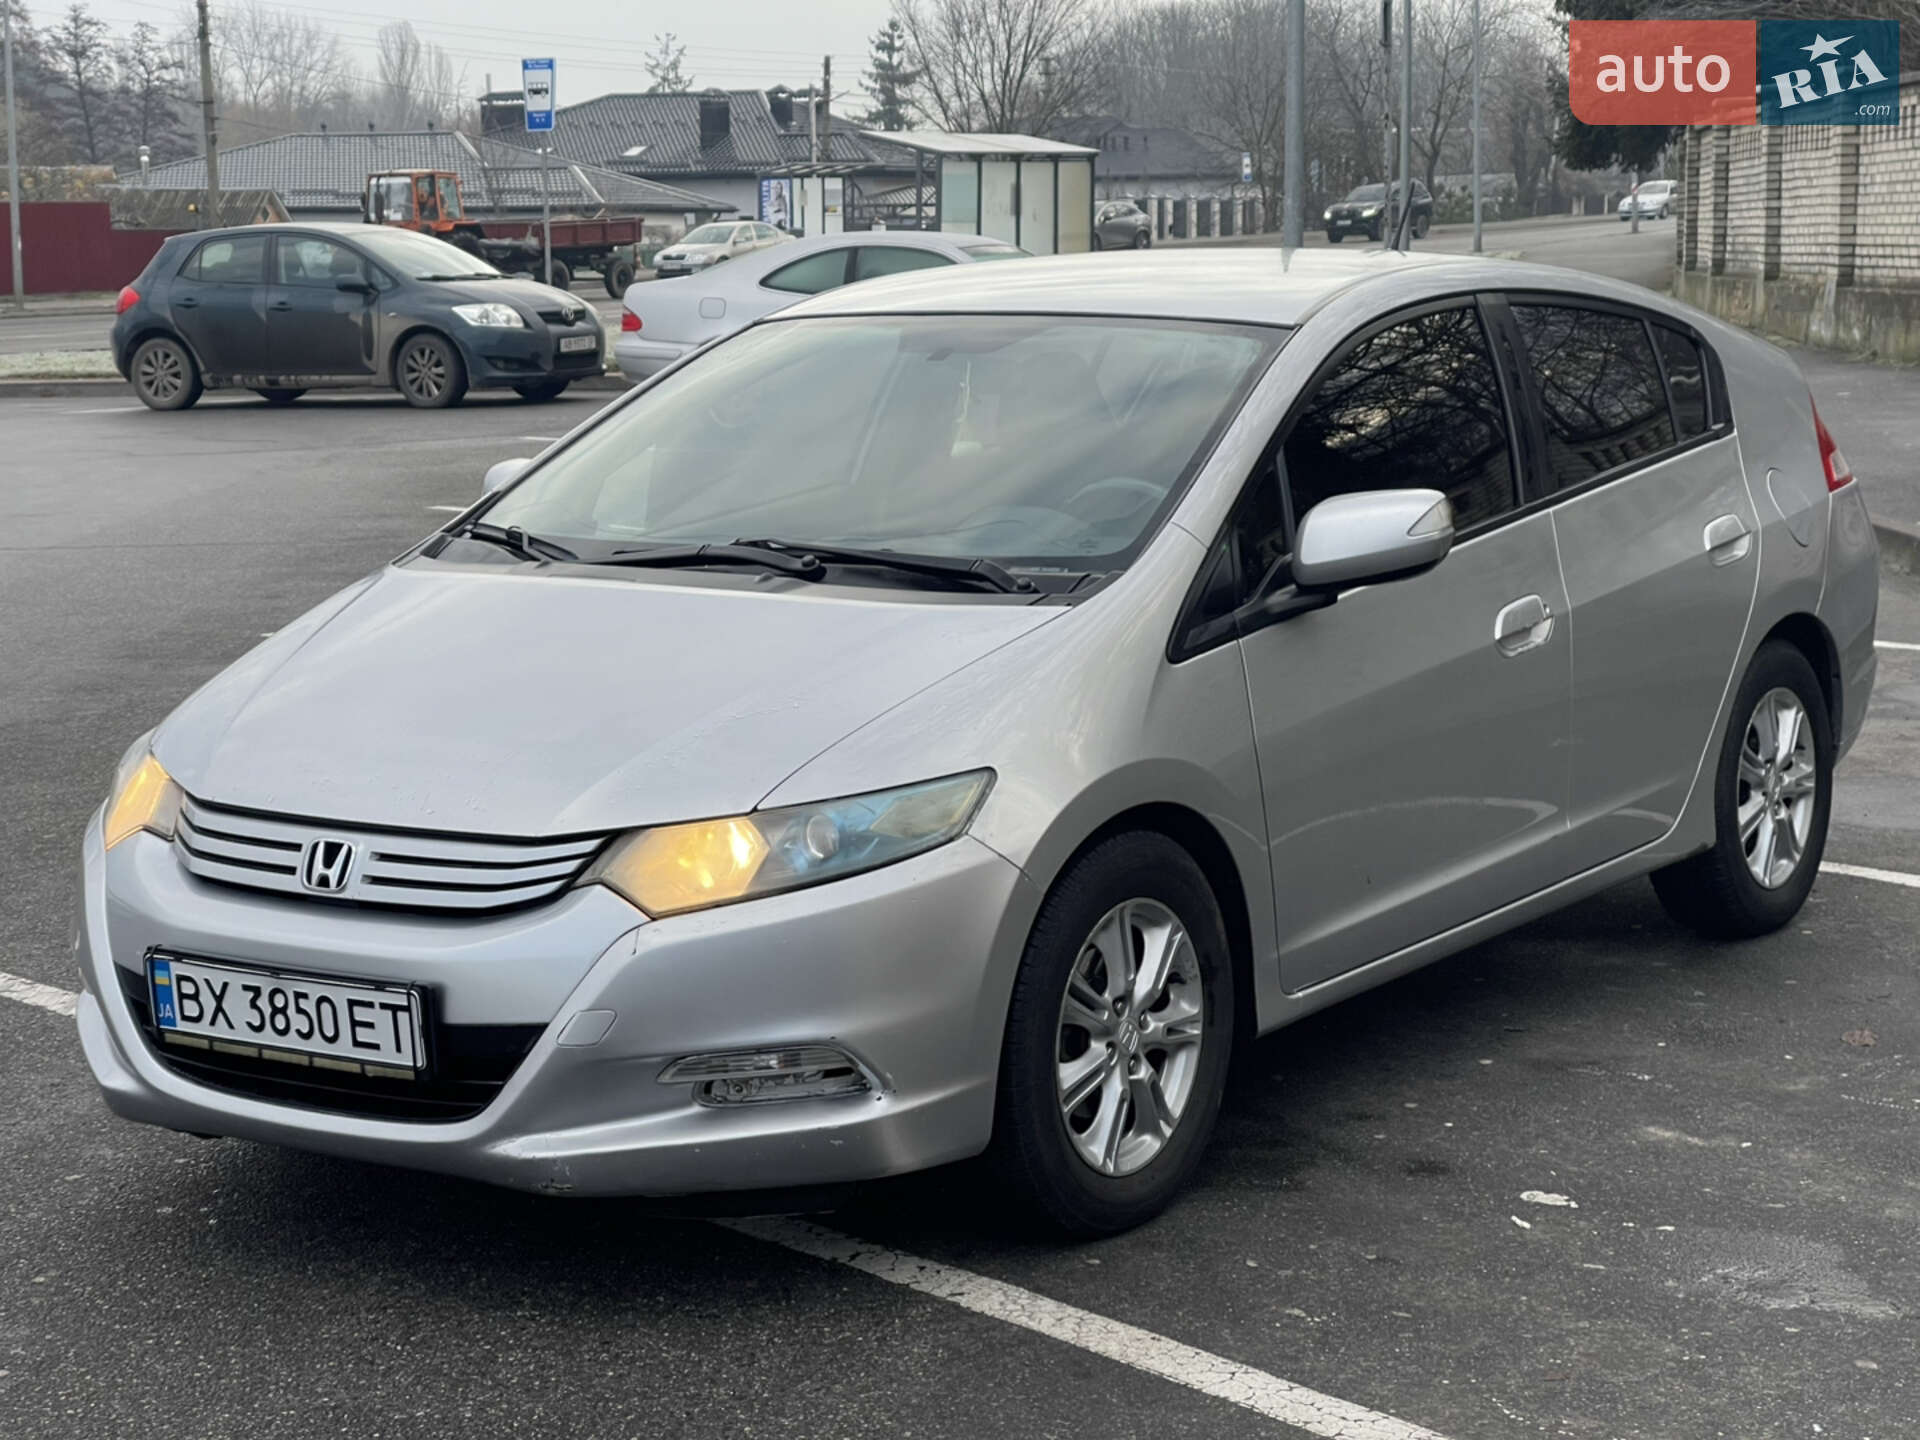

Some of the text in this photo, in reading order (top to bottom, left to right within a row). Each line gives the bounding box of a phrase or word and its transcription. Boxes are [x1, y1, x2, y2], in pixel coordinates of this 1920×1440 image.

[175, 973, 411, 1054] BX 3850 ET
